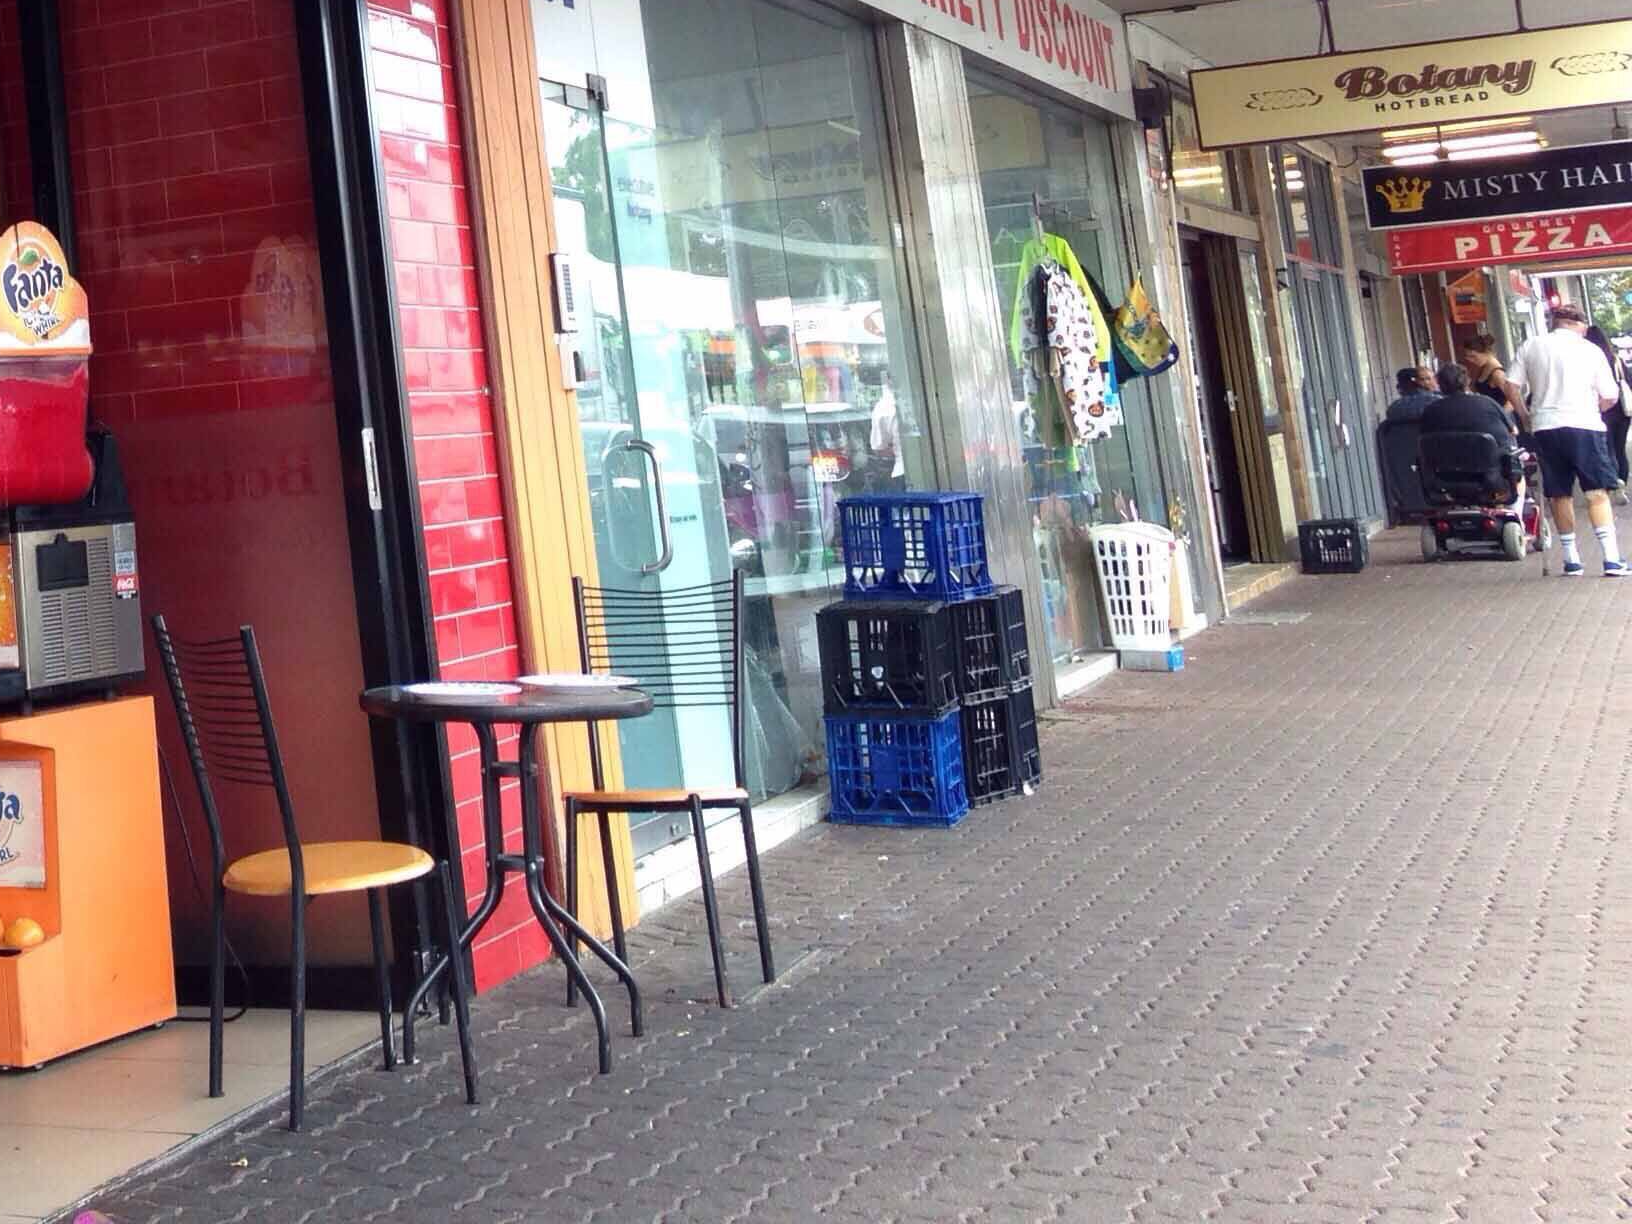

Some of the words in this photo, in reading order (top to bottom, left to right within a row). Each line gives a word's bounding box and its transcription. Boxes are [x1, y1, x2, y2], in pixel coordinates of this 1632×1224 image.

[1334, 59, 1536, 102] Botany
[1374, 90, 1490, 113] HOTBREAD
[1442, 170, 1548, 201] MISTY
[1559, 161, 1632, 188] HAI
[1454, 223, 1613, 260] PIZZA
[1482, 214, 1577, 234] GOURMET
[1, 257, 65, 315] Fanta
